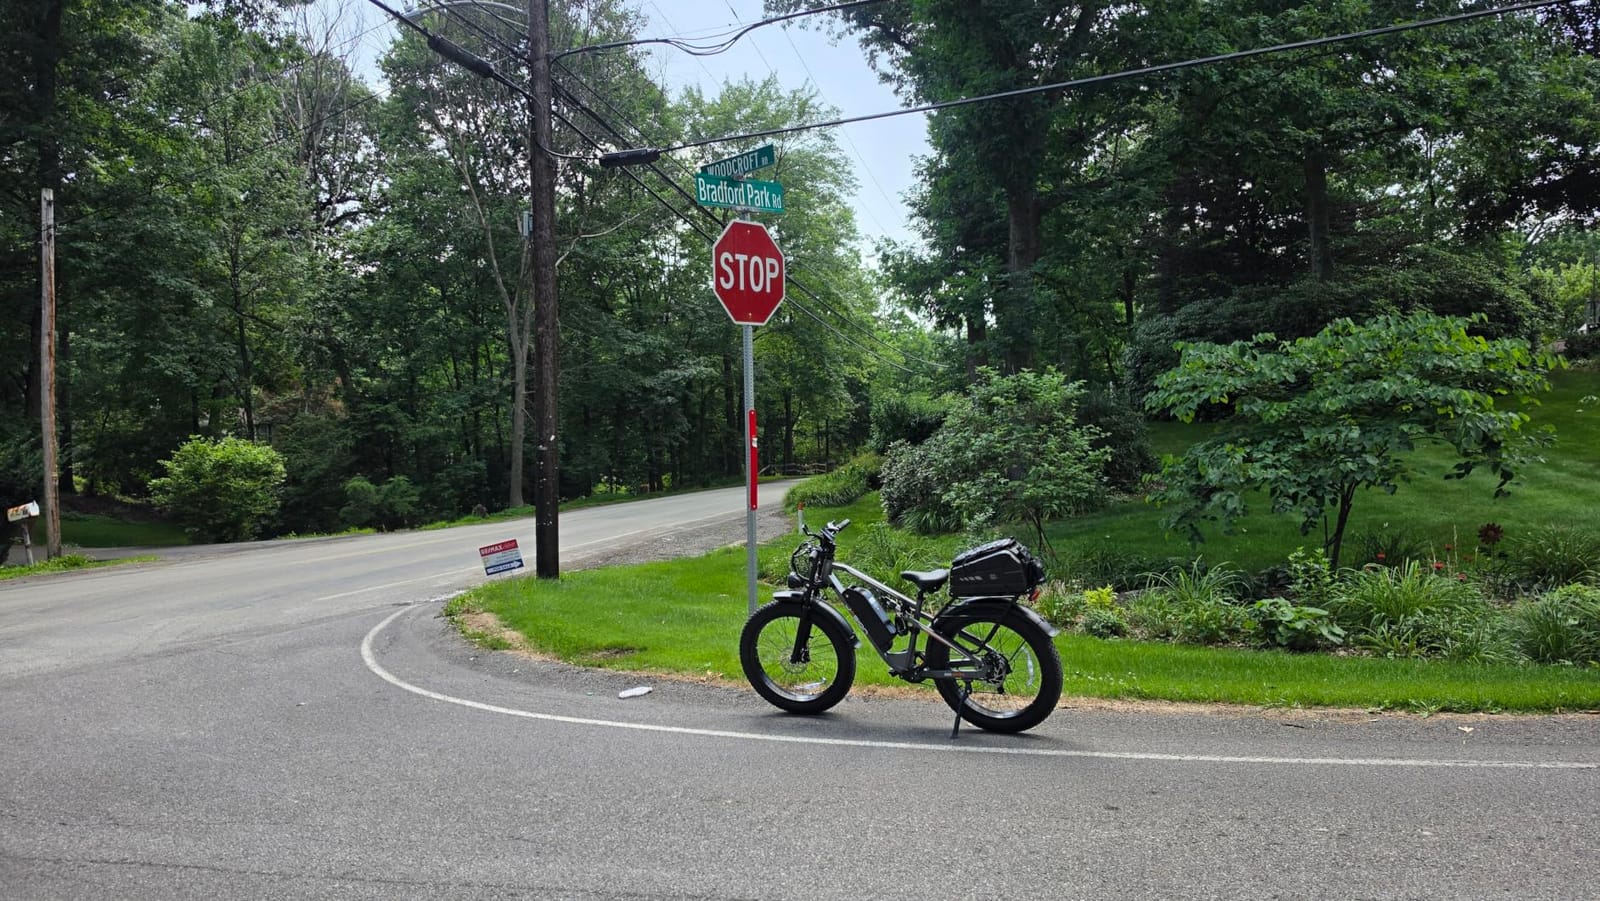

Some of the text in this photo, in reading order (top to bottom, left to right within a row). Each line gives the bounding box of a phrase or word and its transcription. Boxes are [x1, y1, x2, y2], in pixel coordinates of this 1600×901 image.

[707, 152, 759, 177] WOODCROFT
[698, 178, 782, 209] Bradford Park Rd
[719, 252, 780, 293] STOP
